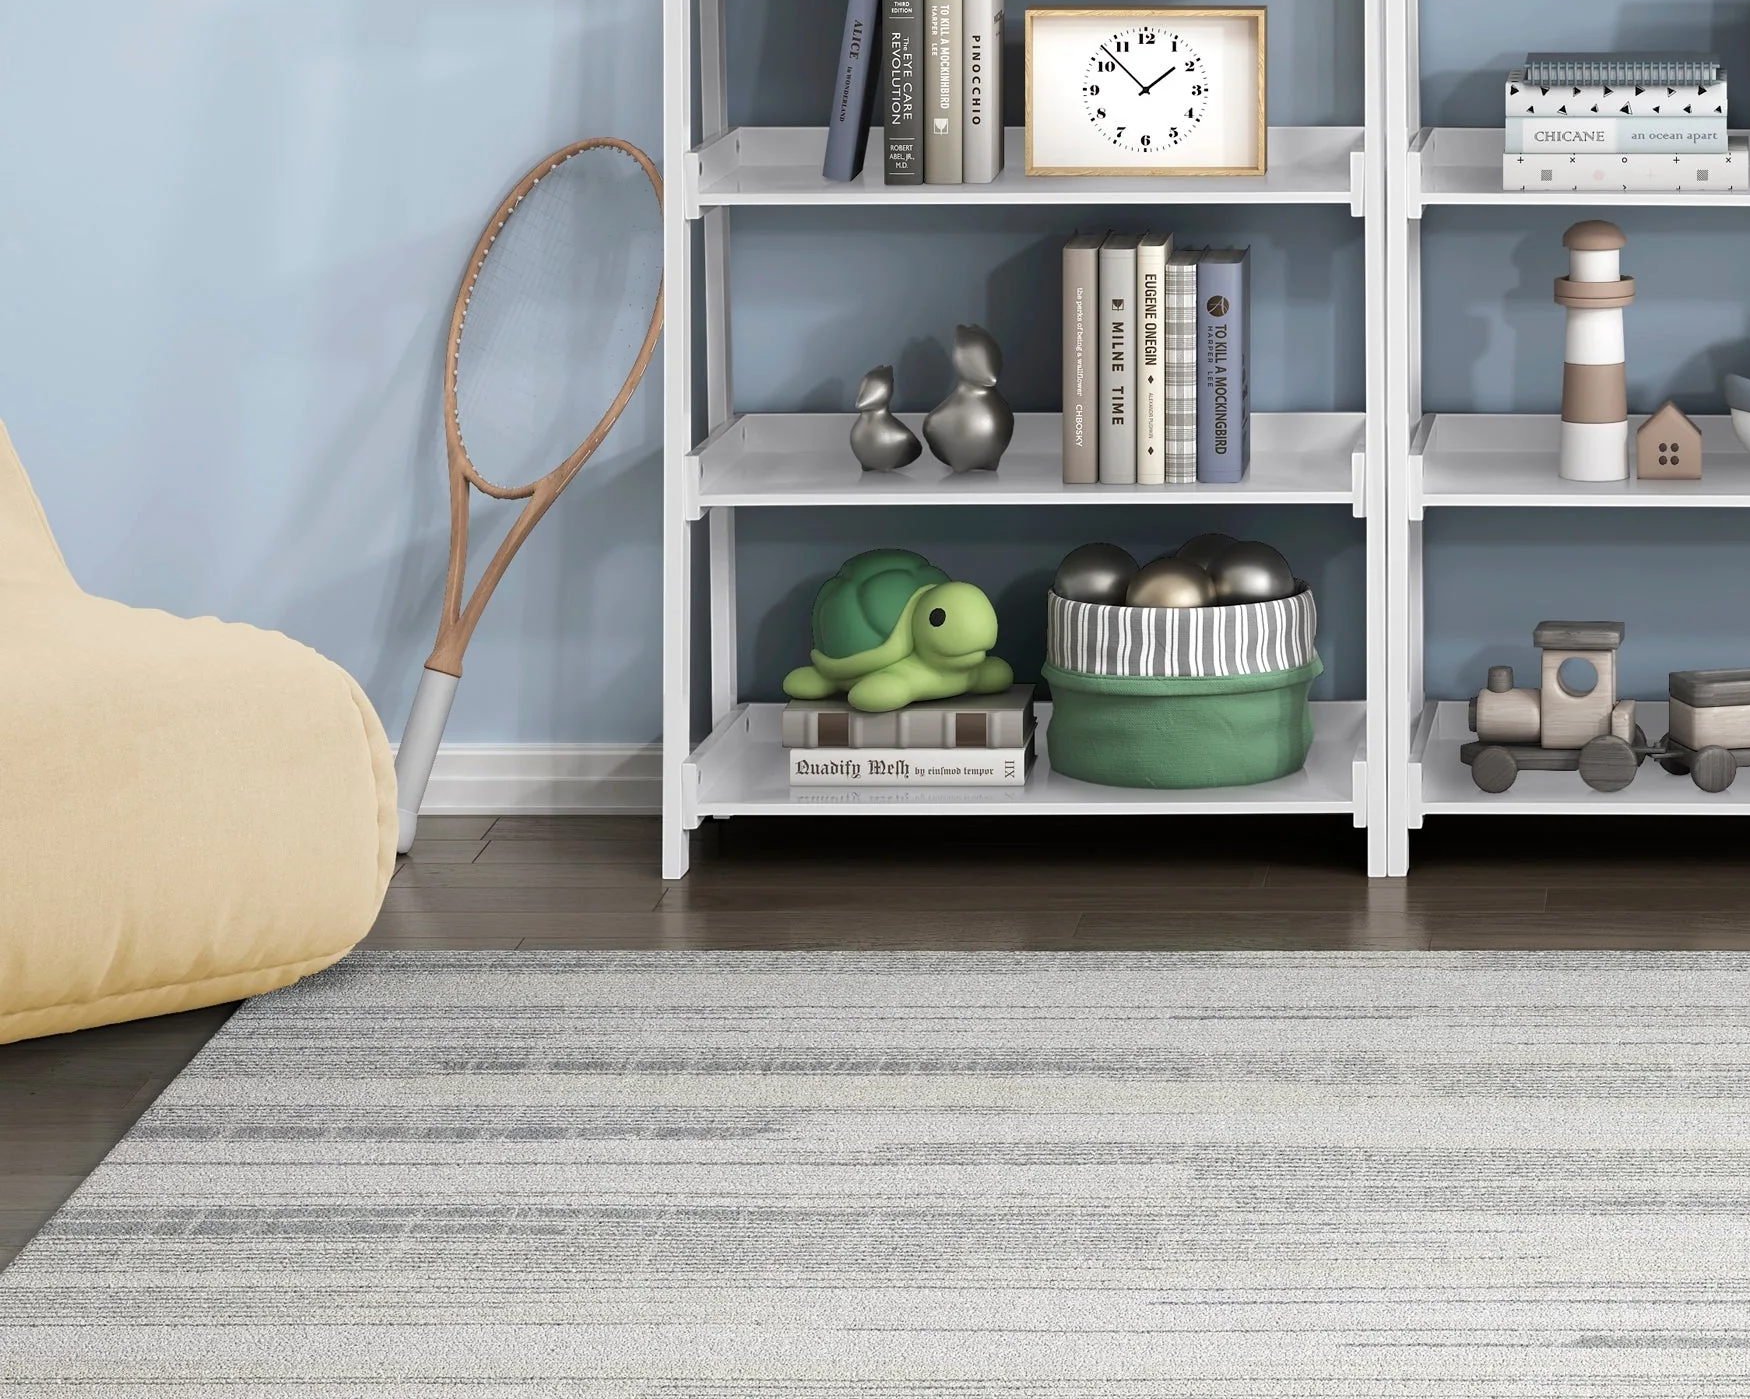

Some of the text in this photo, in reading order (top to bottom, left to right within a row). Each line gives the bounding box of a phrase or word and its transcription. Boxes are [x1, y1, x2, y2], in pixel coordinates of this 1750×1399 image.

[940, 4, 950, 16] TO
[940, 17, 950, 37] KILL
[849, 19, 863, 60] ALICE
[1138, 33, 1155, 44] 12
[1116, 41, 1129, 52] 11
[1171, 41, 1177, 52] 1
[903, 53, 913, 77] EYE
[1097, 61, 1115, 72] 10
[1185, 61, 1195, 72] 2
[891, 32, 901, 125] REVOLUTION
[972, 35, 981, 125] PINOCCHIO
[1090, 85, 1100, 96] 9
[1191, 85, 1202, 96] 3
[839, 75, 853, 122] WONDERLAND
[903, 82, 913, 120] CARE
[1096, 108, 1106, 119] 8
[1184, 107, 1194, 118] 4
[1116, 126, 1126, 138] 7
[1168, 126, 1178, 138] 5
[1533, 131, 1605, 142] CHICANE
[1631, 132, 1718, 143] an ocean apart
[1140, 135, 1151, 146] 6
[895, 161, 908, 169] M.D.
[1075, 301, 1083, 321] perks
[1144, 274, 1157, 366] EUGENE ONEGIN
[1076, 322, 1083, 331] of
[1075, 331, 1083, 352] being
[1111, 321, 1124, 425] MILNE TIME
[1214, 323, 1227, 455] TO KILL A MOCKINGBIRD
[1075, 404, 1083, 447] CHBOSKY
[795, 759, 862, 779] Quadify
[914, 767, 926, 777] by
[963, 767, 995, 777] tempor
